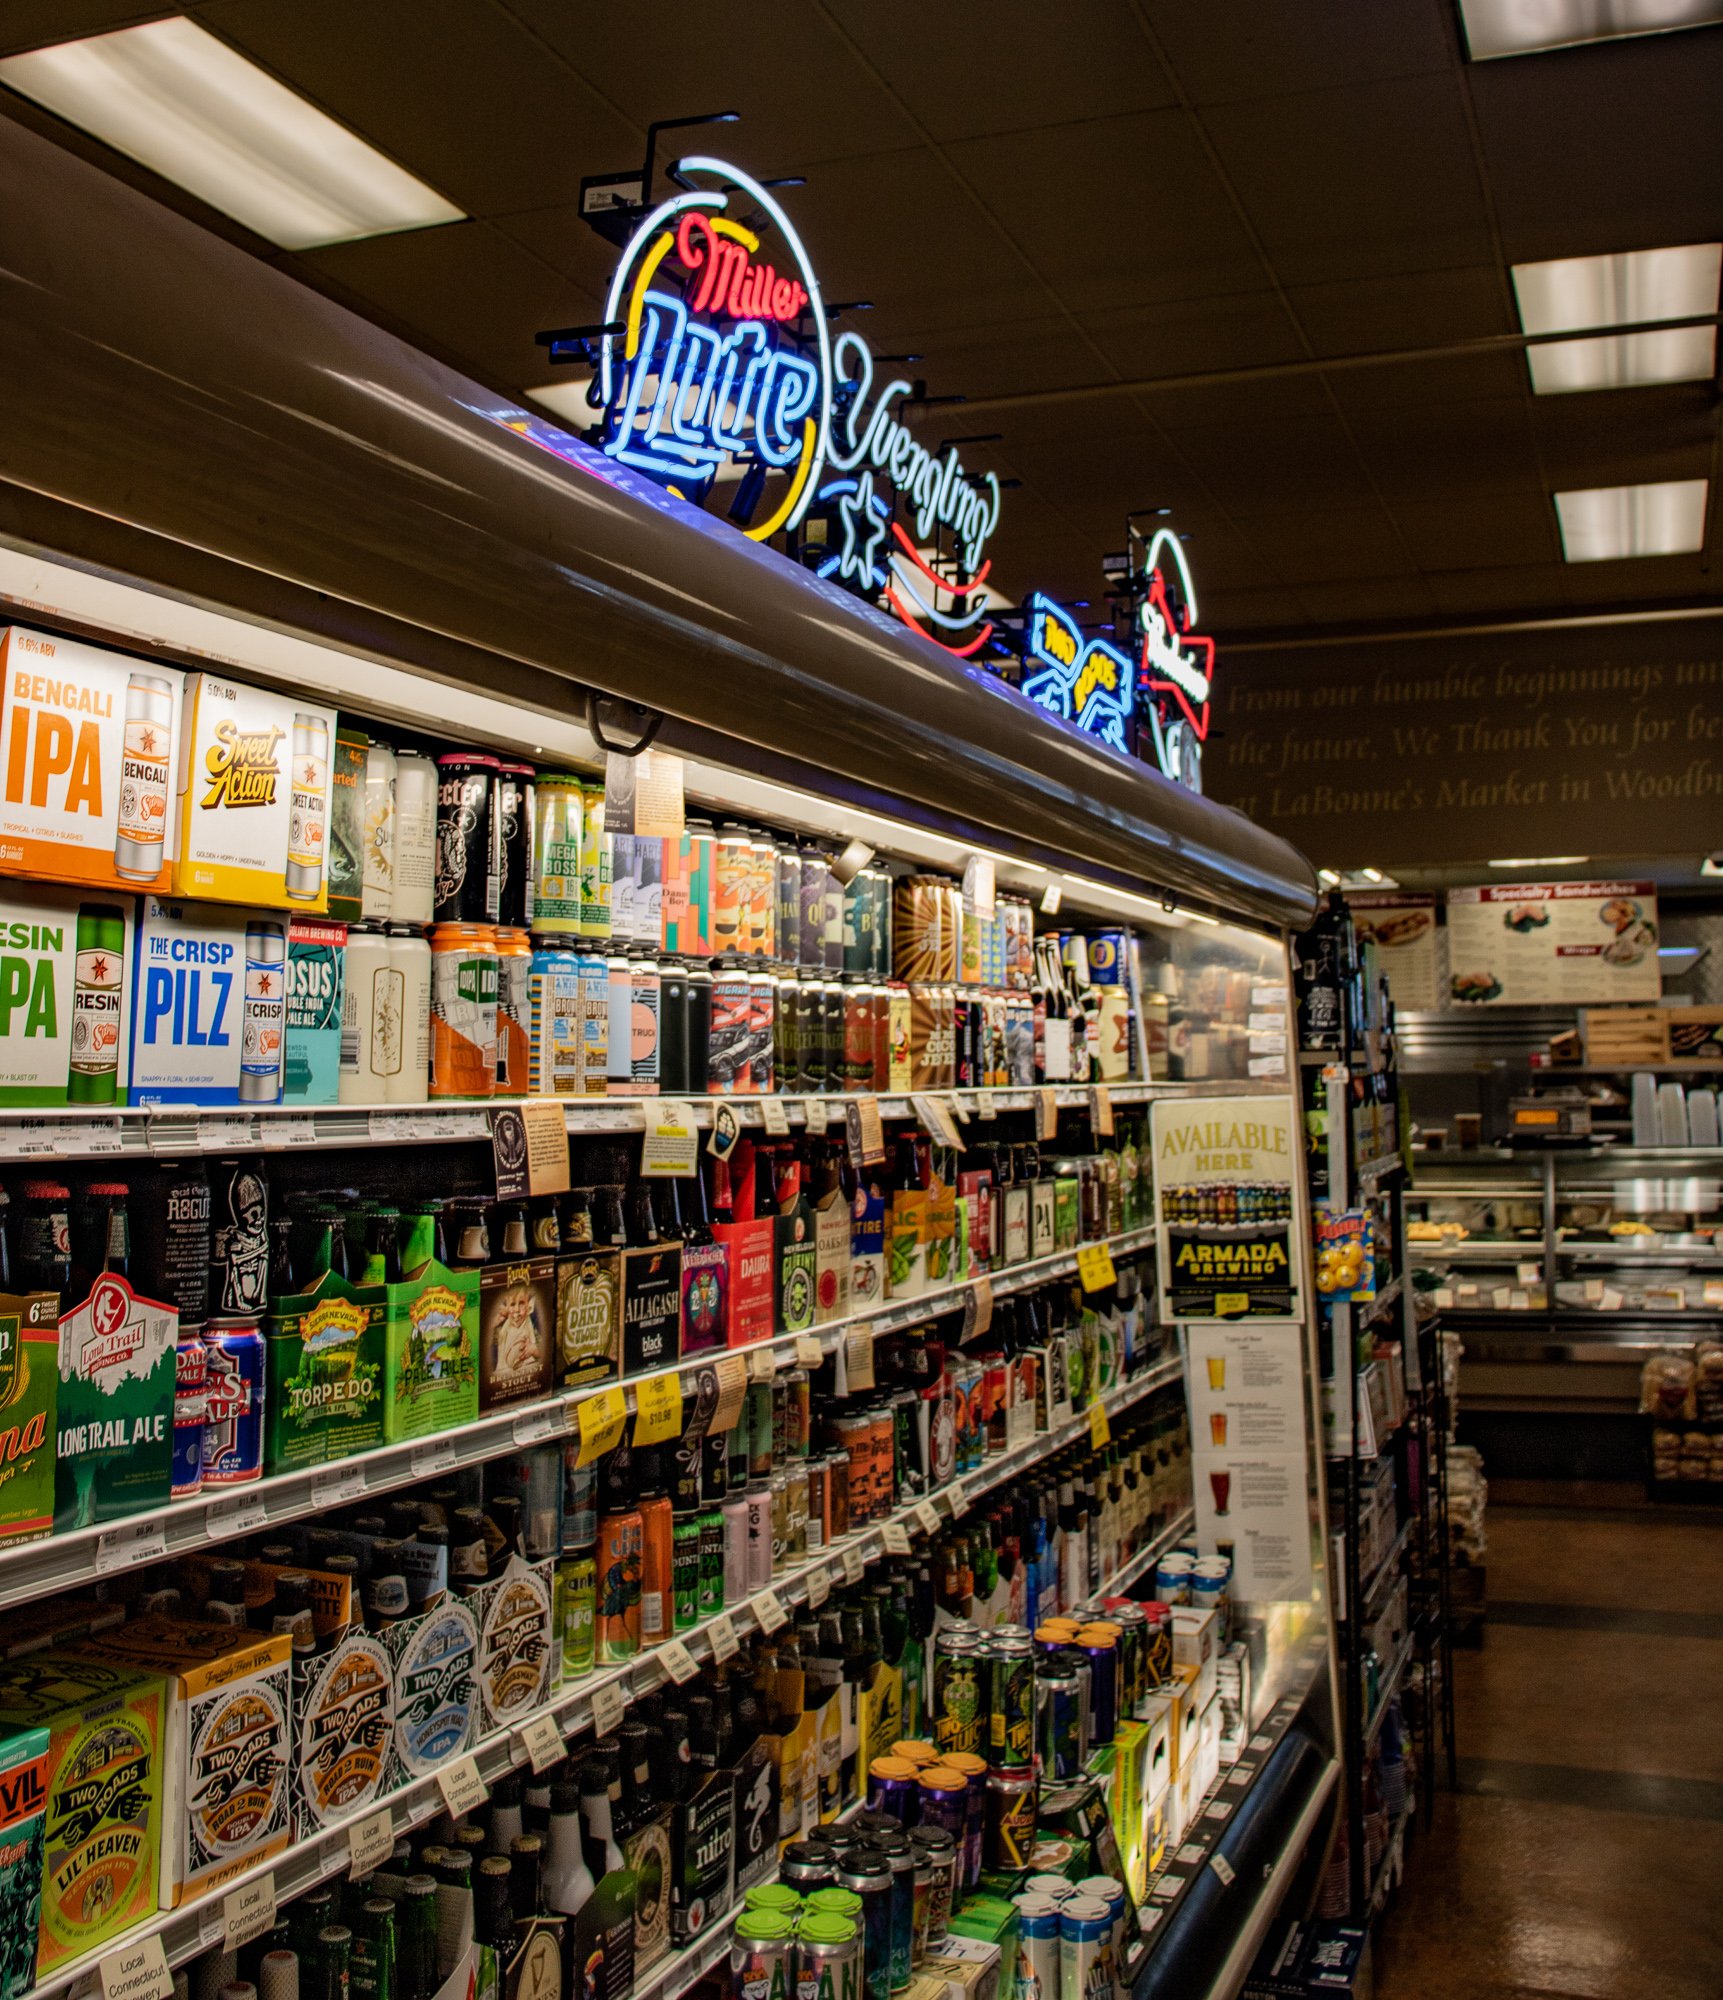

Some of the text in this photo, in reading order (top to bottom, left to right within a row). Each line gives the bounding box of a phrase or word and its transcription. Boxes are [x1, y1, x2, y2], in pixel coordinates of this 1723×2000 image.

[677, 212, 808, 321] Miller
[14, 671, 113, 718] BENGALI
[1373, 664, 1485, 706] humble
[1494, 661, 1664, 708] beginnings
[1393, 726, 1440, 757] We
[1453, 713, 1552, 753] Thank
[1566, 716, 1620, 747] You
[1617, 706, 1677, 759] for
[205, 719, 287, 774] Sweet
[5, 705, 103, 817] IPA
[200, 760, 280, 810] Action
[1436, 770, 1548, 809] Market
[1561, 771, 1590, 801] in
[310, 927, 334, 941] BREWING
[150, 936, 234, 965] THE CRISP
[75, 992, 120, 1012] RESIN
[143, 967, 233, 1047] PILZ
[253, 1004, 282, 1020] CRISP
[1161, 1122, 1289, 1160] AVAILABLE
[1196, 1153, 1254, 1172] HERE
[741, 1254, 770, 1280] DAURA
[1175, 1242, 1288, 1267] ARMADA
[1189, 1262, 1276, 1275] BREWING
[29, 1302, 41, 1323] 6
[432, 1295, 457, 1310] NEVADA
[625, 1289, 679, 1324] ALLAGASH
[309, 1309, 359, 1330] SIERRA NEVADA
[570, 1306, 606, 1328] DANK
[106, 1325, 142, 1352] Trail
[642, 1332, 663, 1354] black
[404, 1366, 433, 1387] PALE
[440, 1356, 470, 1377] ALE
[501, 1374, 532, 1390] STOUT
[291, 1377, 373, 1409] TORPEDO
[57, 1414, 166, 1459] LONG TRAIL ALE
[494, 1633, 510, 1648] TWO
[507, 1615, 540, 1656] ROADS
[414, 1670, 439, 1691] TWO
[436, 1652, 469, 1700] ROADS
[322, 1712, 344, 1733] TWO
[342, 1692, 381, 1740] ROADS
[234, 1731, 271, 1778] ROADS
[431, 1736, 452, 1754] IPA
[209, 1748, 235, 1770] TWO
[323, 1765, 343, 1796] ROAD
[354, 1755, 376, 1773] RUIN
[450, 1768, 467, 1785] Local
[69, 1784, 98, 1809] TWO
[94, 1764, 139, 1816] ROADS
[338, 1784, 359, 1803] IPA
[447, 1778, 481, 1802] Connecticut
[456, 1792, 481, 1812] Brewery
[211, 1806, 235, 1831] ROAD
[247, 1795, 266, 1809] RUIN
[230, 1823, 252, 1841] IPA
[362, 1822, 380, 1841] Local
[354, 1832, 392, 1860] Connecticut
[695, 1826, 732, 1870] nitro
[57, 1834, 141, 1892] LIL' HEAVEN
[360, 1852, 386, 1873] Brewery
[239, 1889, 260, 1911] Local
[228, 1901, 273, 1933] Connecticut
[235, 1921, 267, 1946] Brewery
[119, 1951, 146, 1975] Local
[108, 1963, 166, 1999] Connecticut
